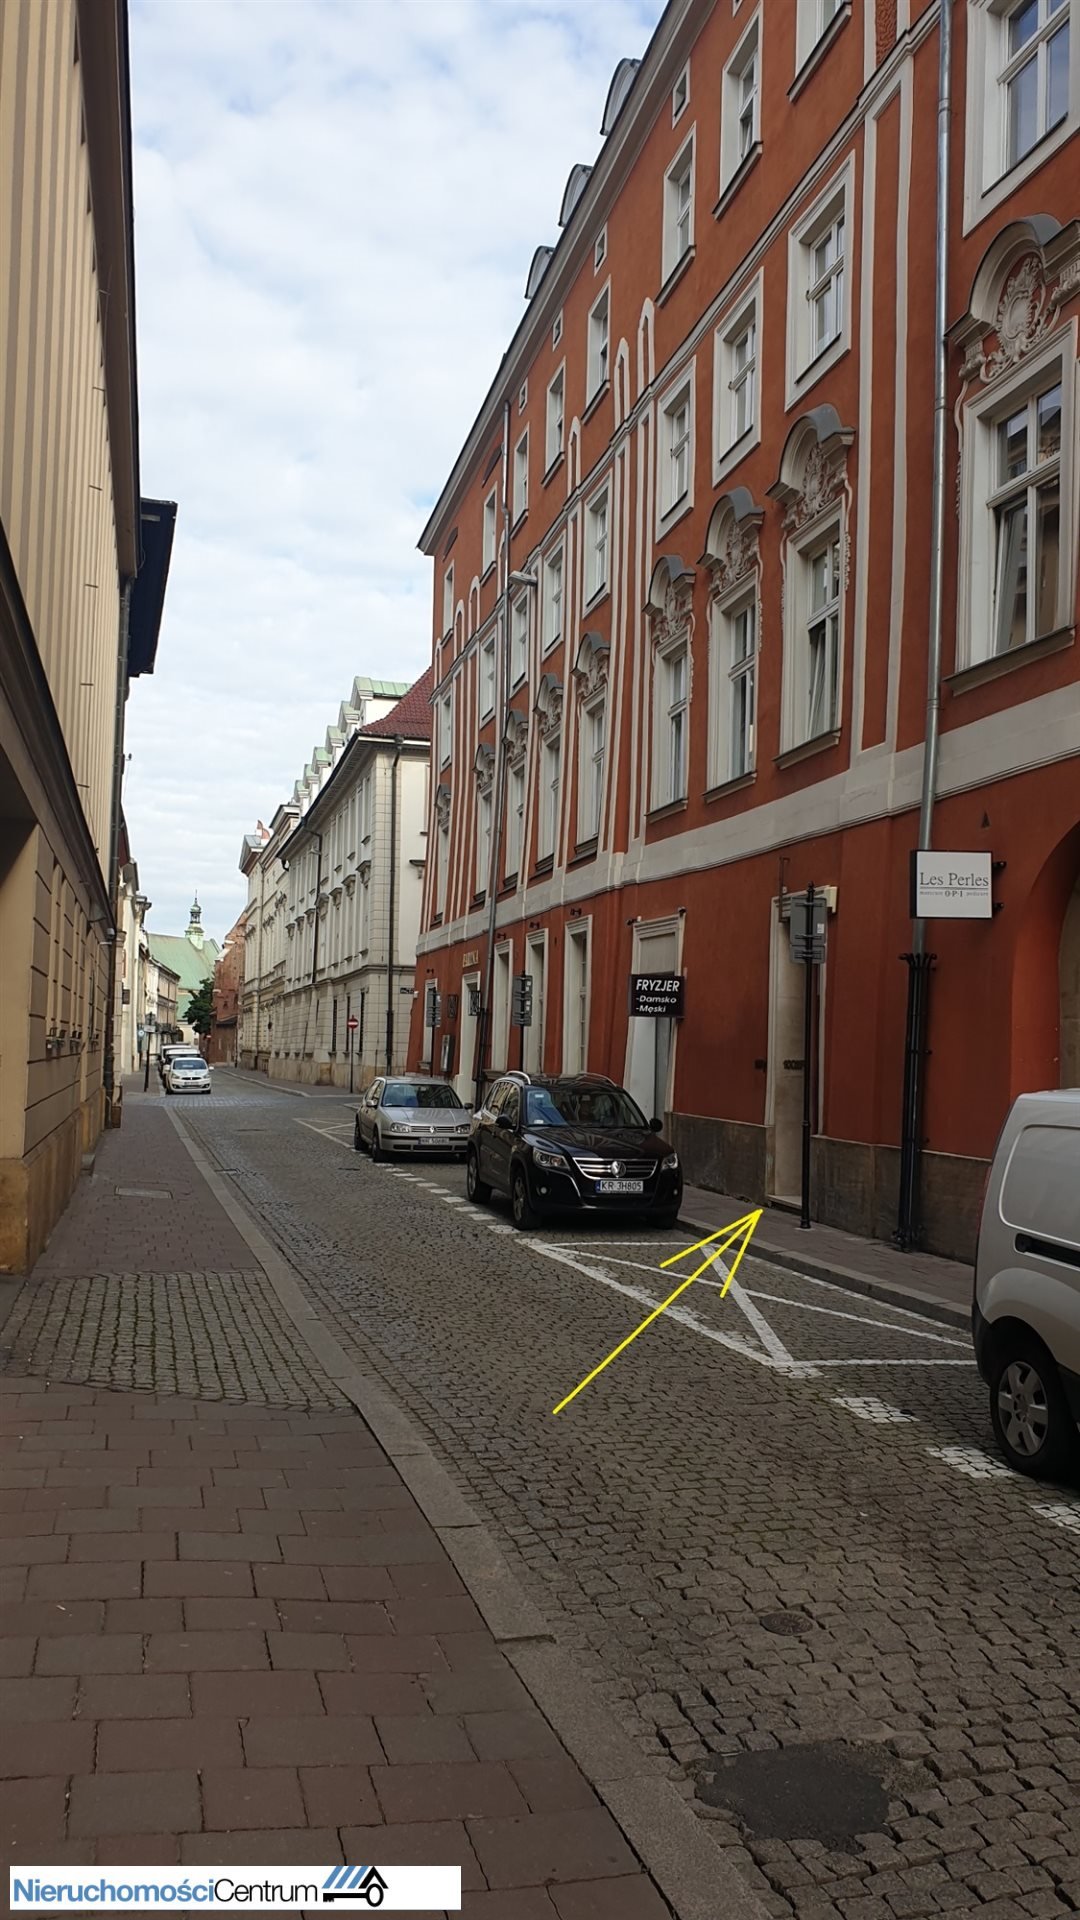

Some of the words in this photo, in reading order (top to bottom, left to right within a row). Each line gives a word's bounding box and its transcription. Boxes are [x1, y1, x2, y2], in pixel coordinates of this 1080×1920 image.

[920, 872, 944, 886] Les
[948, 872, 989, 887] Perles
[635, 979, 680, 992] FRYZJER
[601, 1181, 614, 1191] KR
